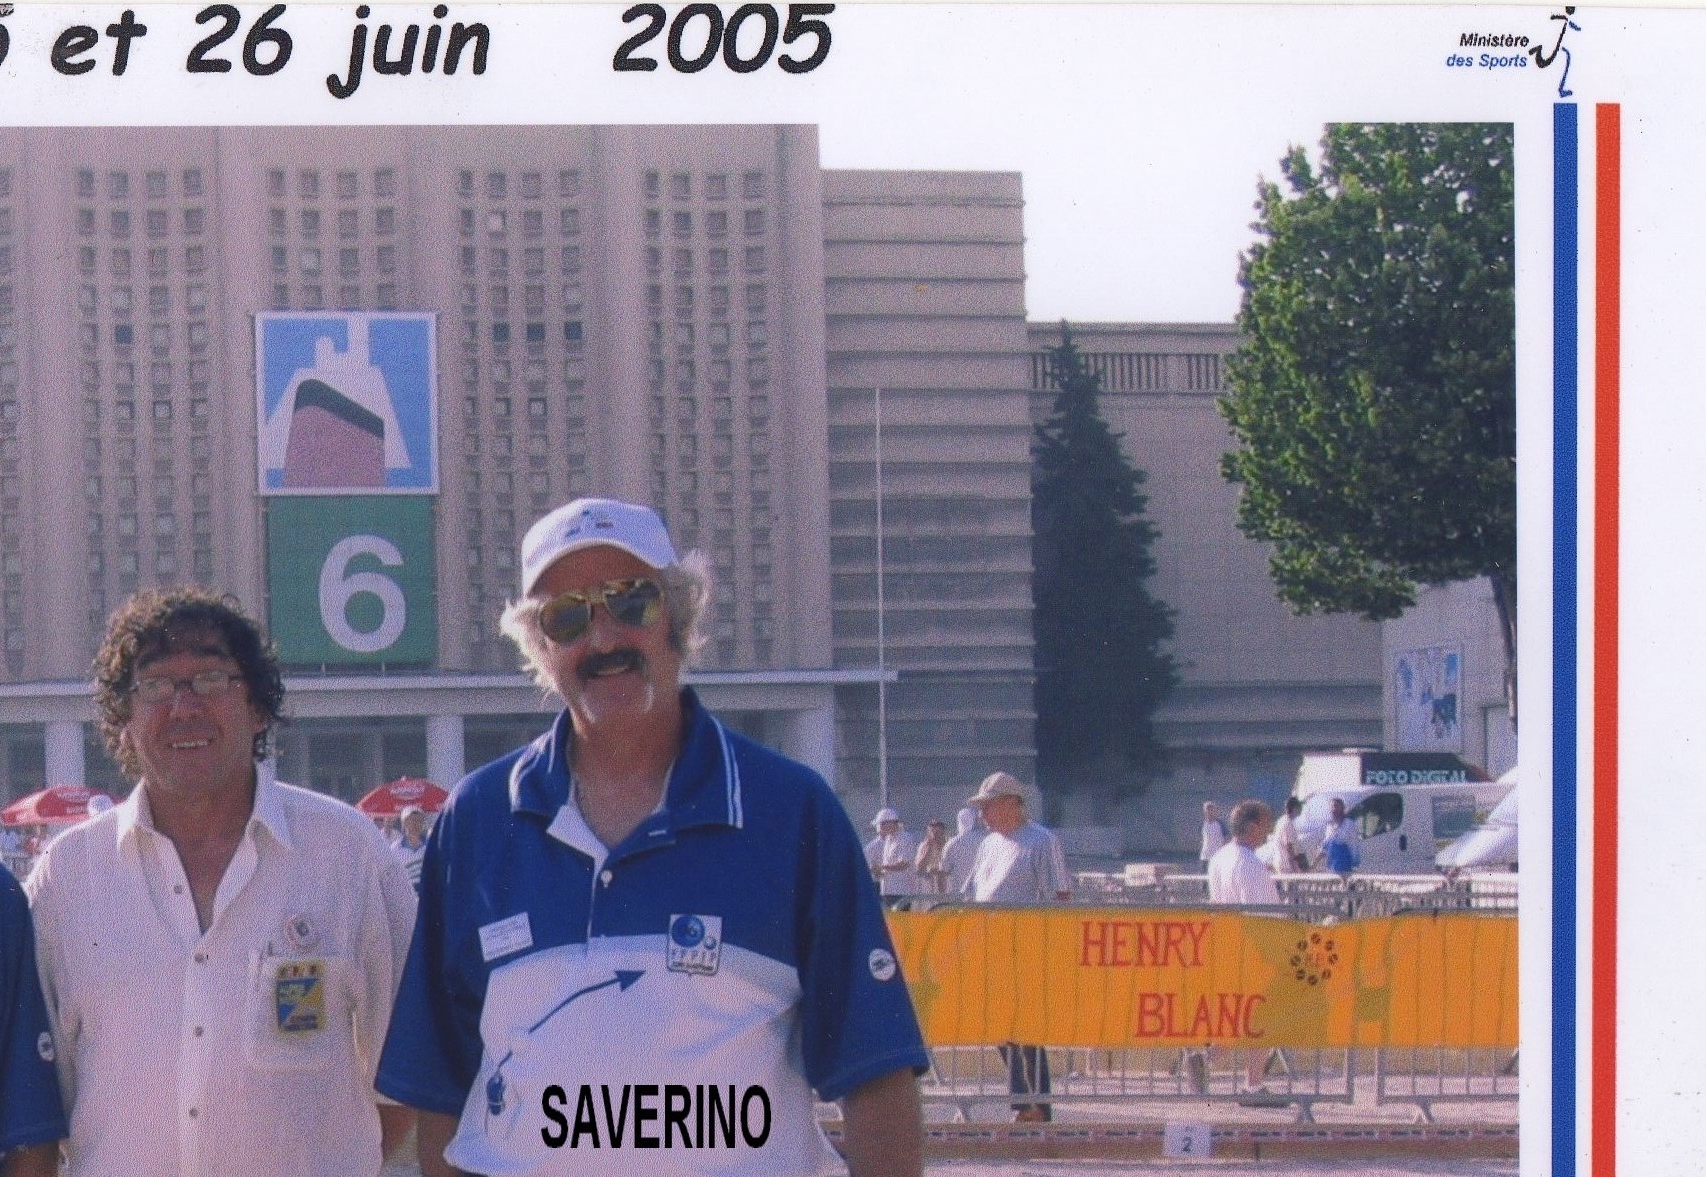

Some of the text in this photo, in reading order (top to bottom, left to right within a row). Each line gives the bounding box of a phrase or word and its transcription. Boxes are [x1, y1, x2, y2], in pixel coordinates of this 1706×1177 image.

[319, 533, 407, 653] 6
[1080, 921, 1212, 966] HENRY
[1135, 992, 1268, 1038] BLANC
